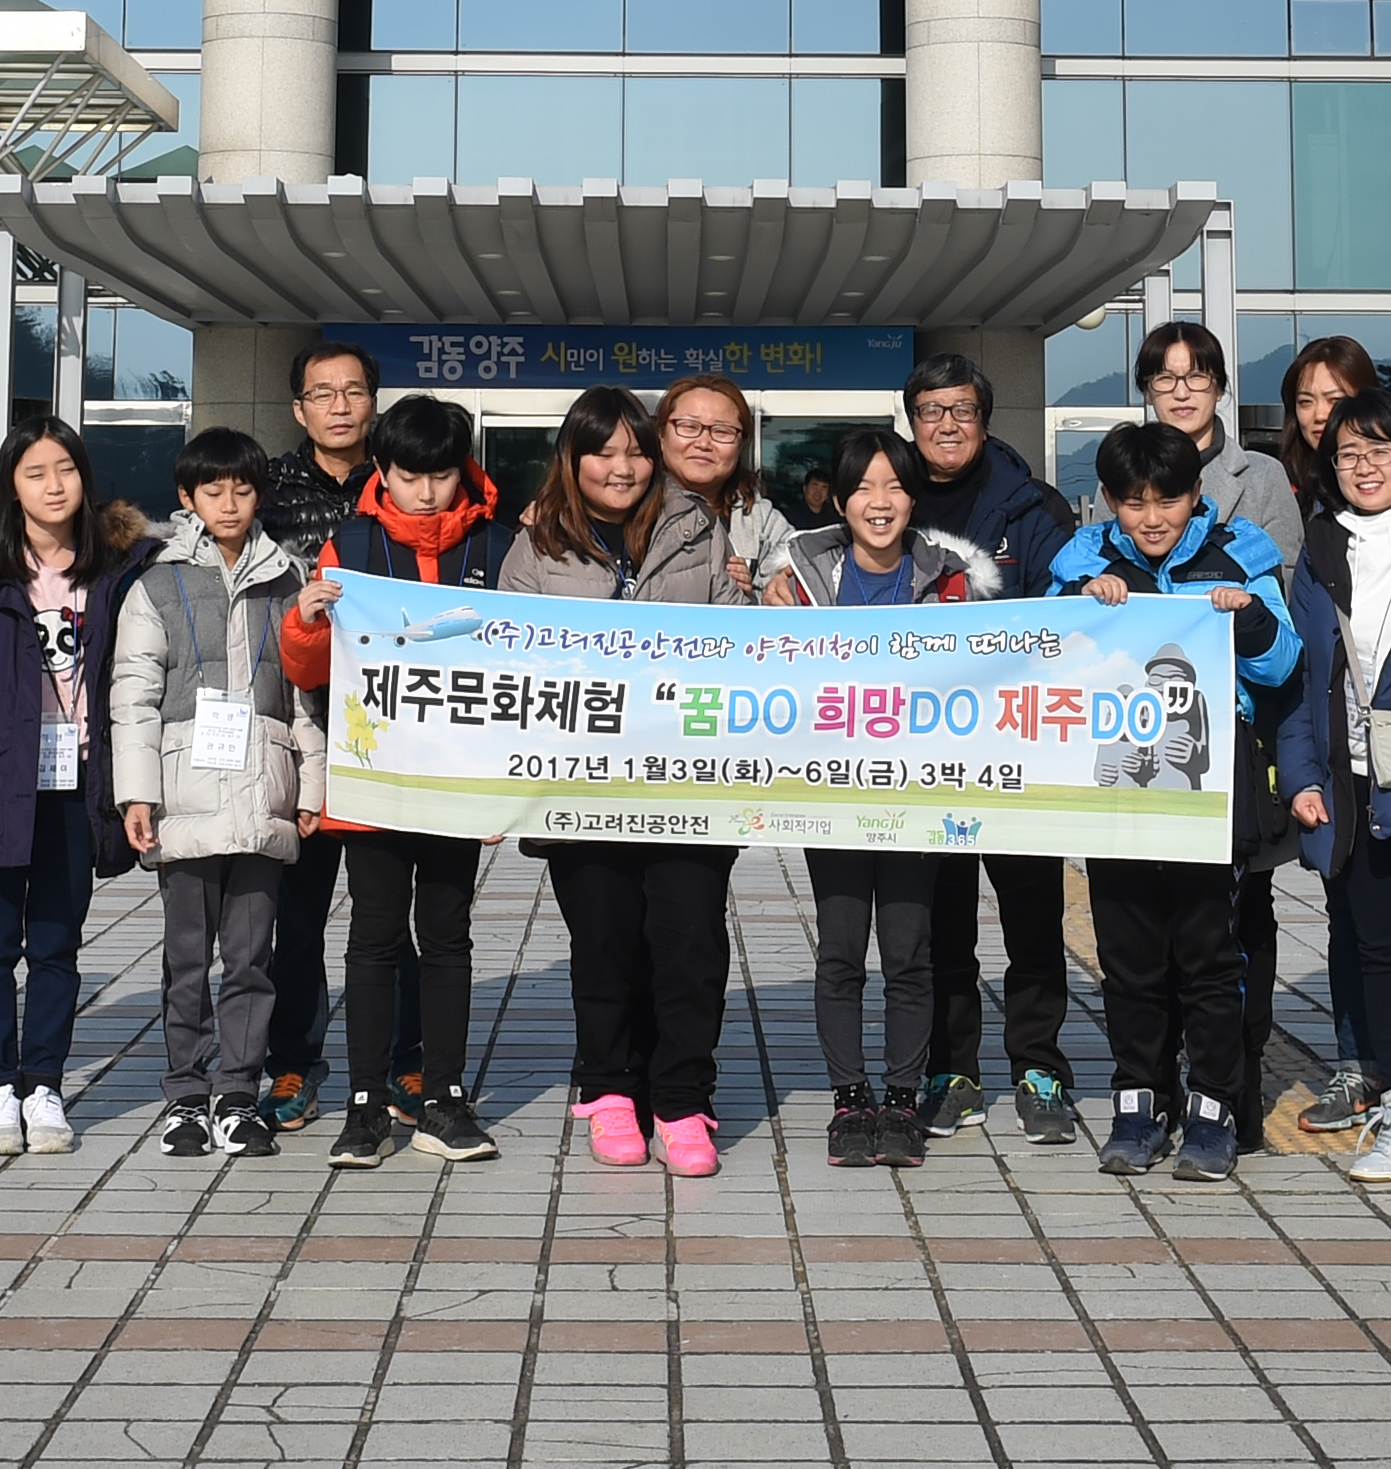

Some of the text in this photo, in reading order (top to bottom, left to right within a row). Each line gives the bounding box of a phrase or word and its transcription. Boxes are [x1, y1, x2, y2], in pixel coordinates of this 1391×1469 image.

[540, 340, 604, 373] 시민이
[610, 341, 678, 373] 원하는
[683, 341, 753, 374] 확실한
[760, 341, 823, 374] 변화!
[483, 620, 1062, 663] (주)고려진공안전과 양주시청이 함께 떠나는
[361, 664, 627, 734] 제주문화체험
[813, 685, 979, 739] 희망DO
[508, 754, 610, 782] 2017년
[920, 761, 967, 789] 3박
[977, 762, 1025, 791] 4일
[544, 809, 710, 836] (주)고려진공안전
[768, 819, 832, 835] 사회적기업
[865, 832, 897, 844] 양주시
[946, 834, 976, 846] 365
